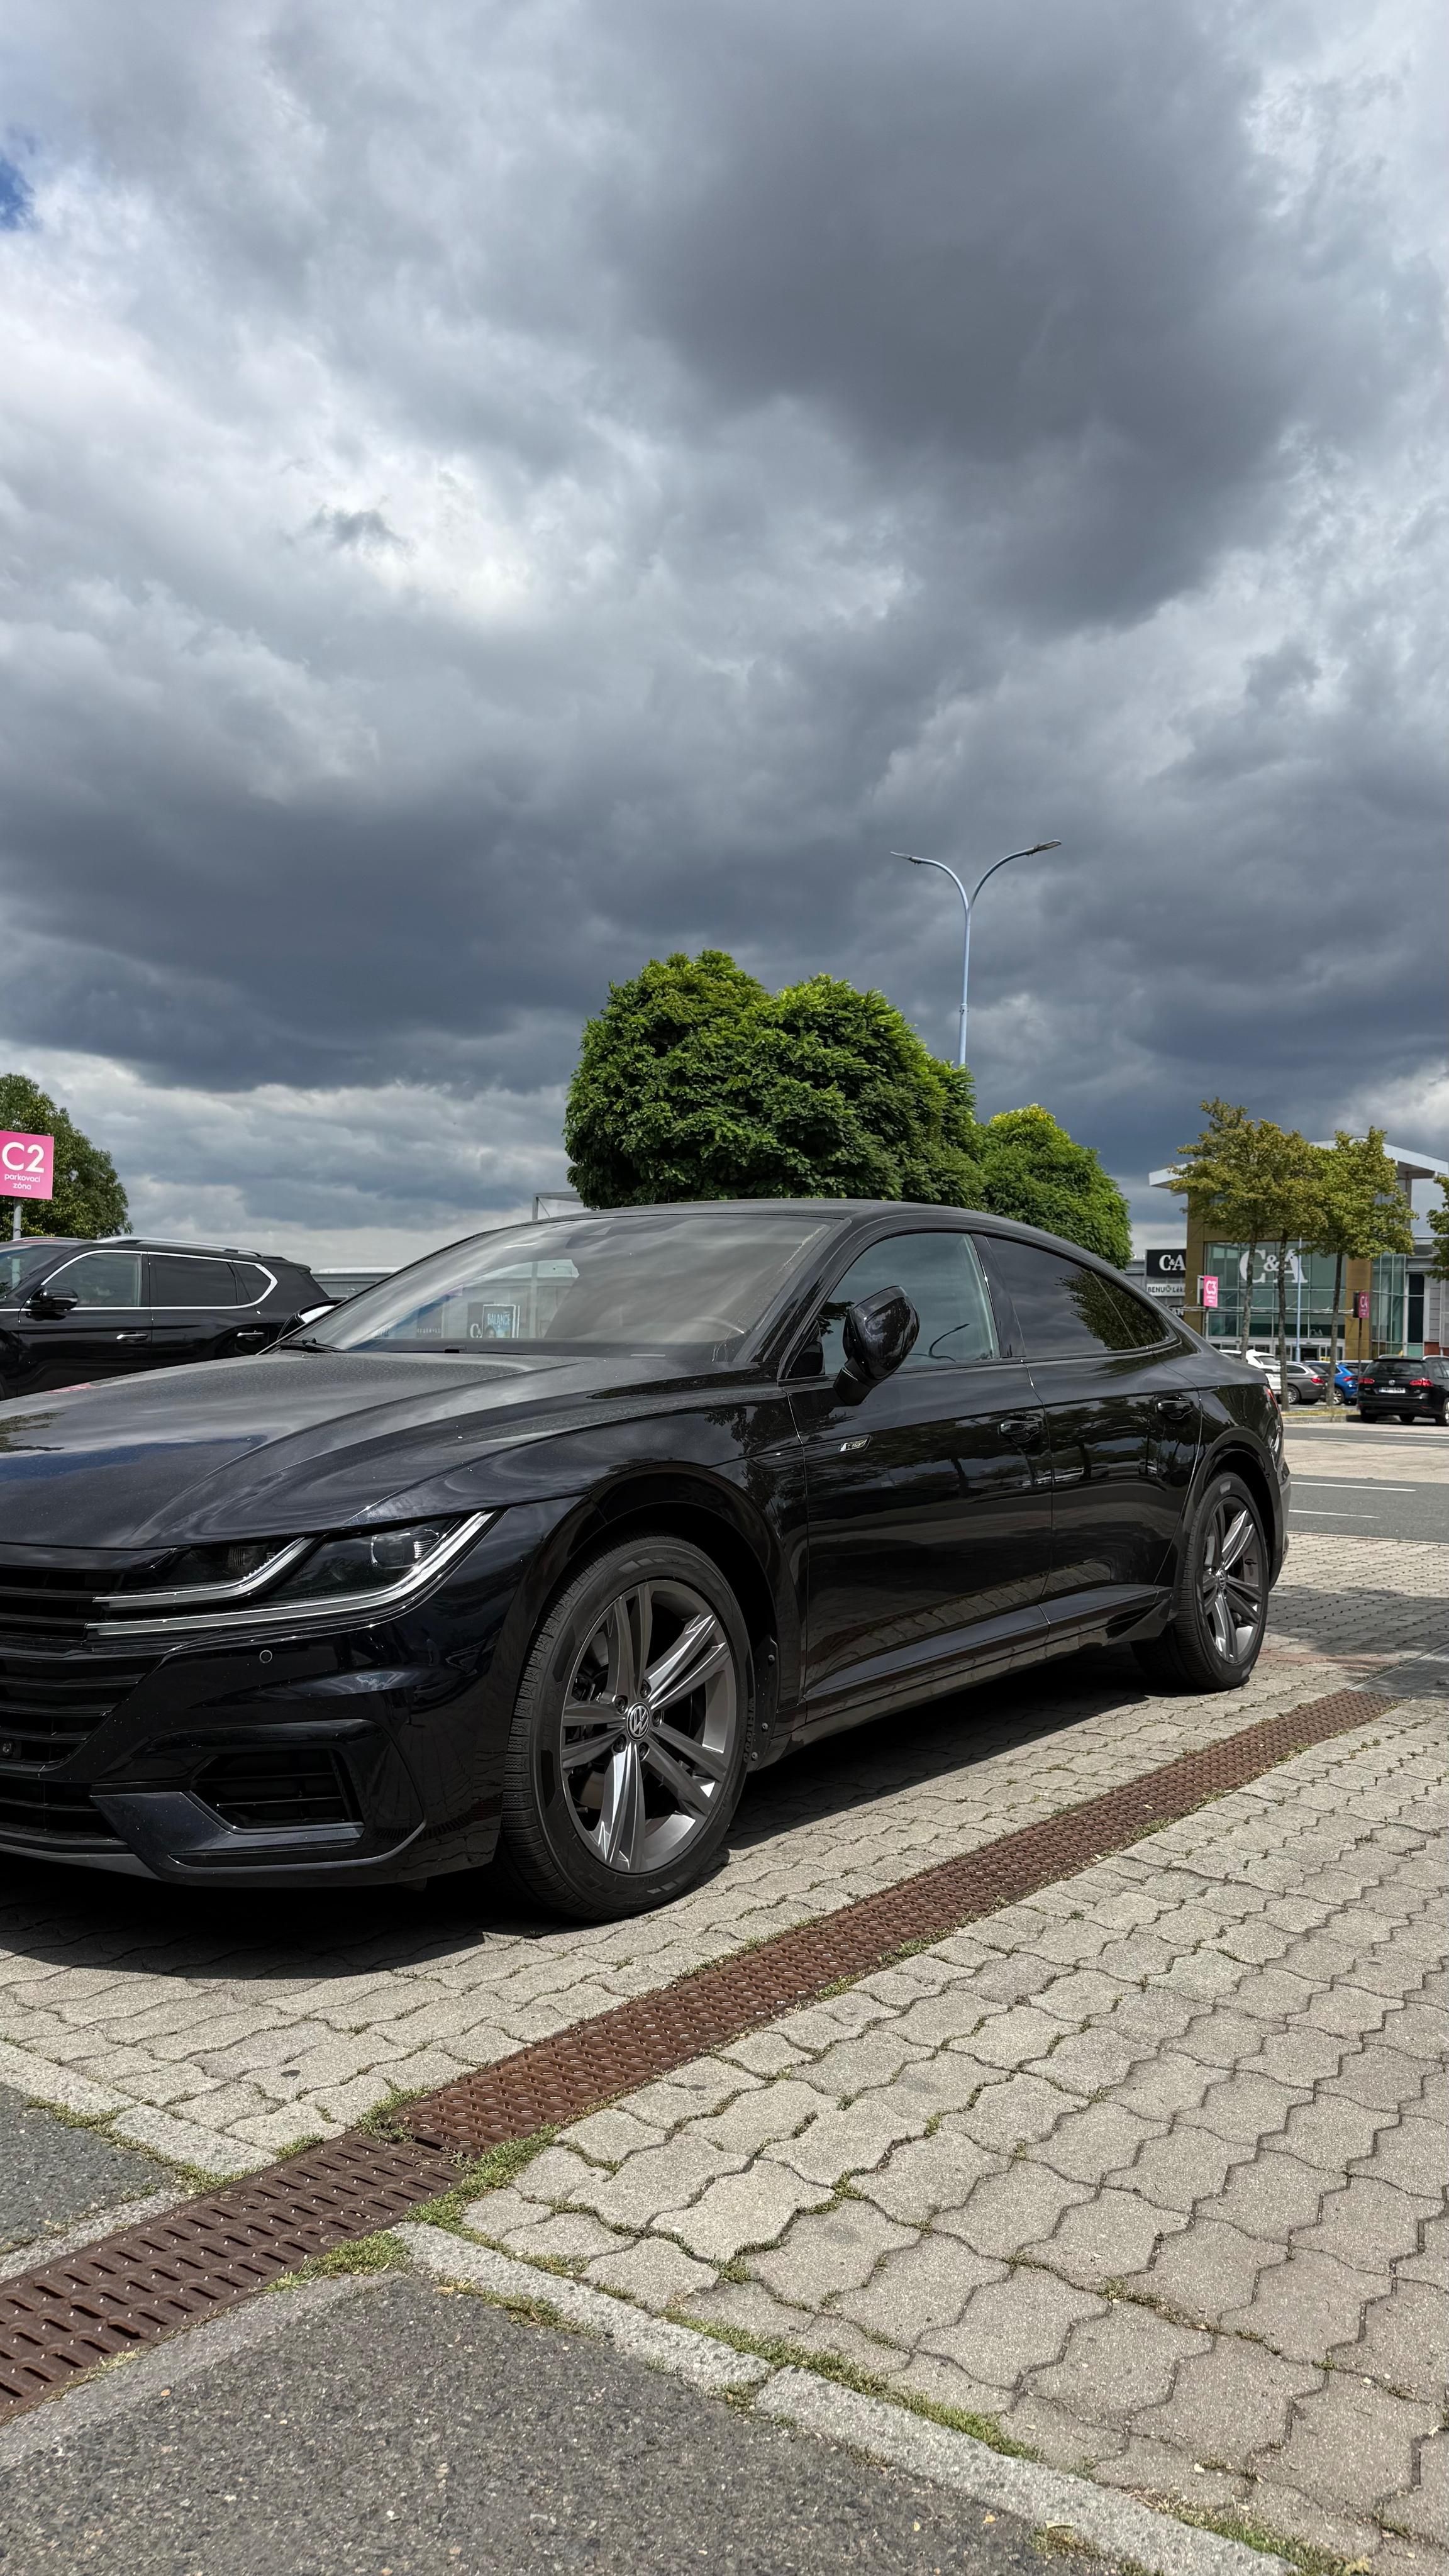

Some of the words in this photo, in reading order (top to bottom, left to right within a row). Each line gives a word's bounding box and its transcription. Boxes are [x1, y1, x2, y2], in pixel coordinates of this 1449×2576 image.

[2, 1141, 45, 1174] C2
[1158, 1255, 1186, 1271] C&A
[1240, 1249, 1309, 1284] C&A
[1206, 1280, 1217, 1295] C3
